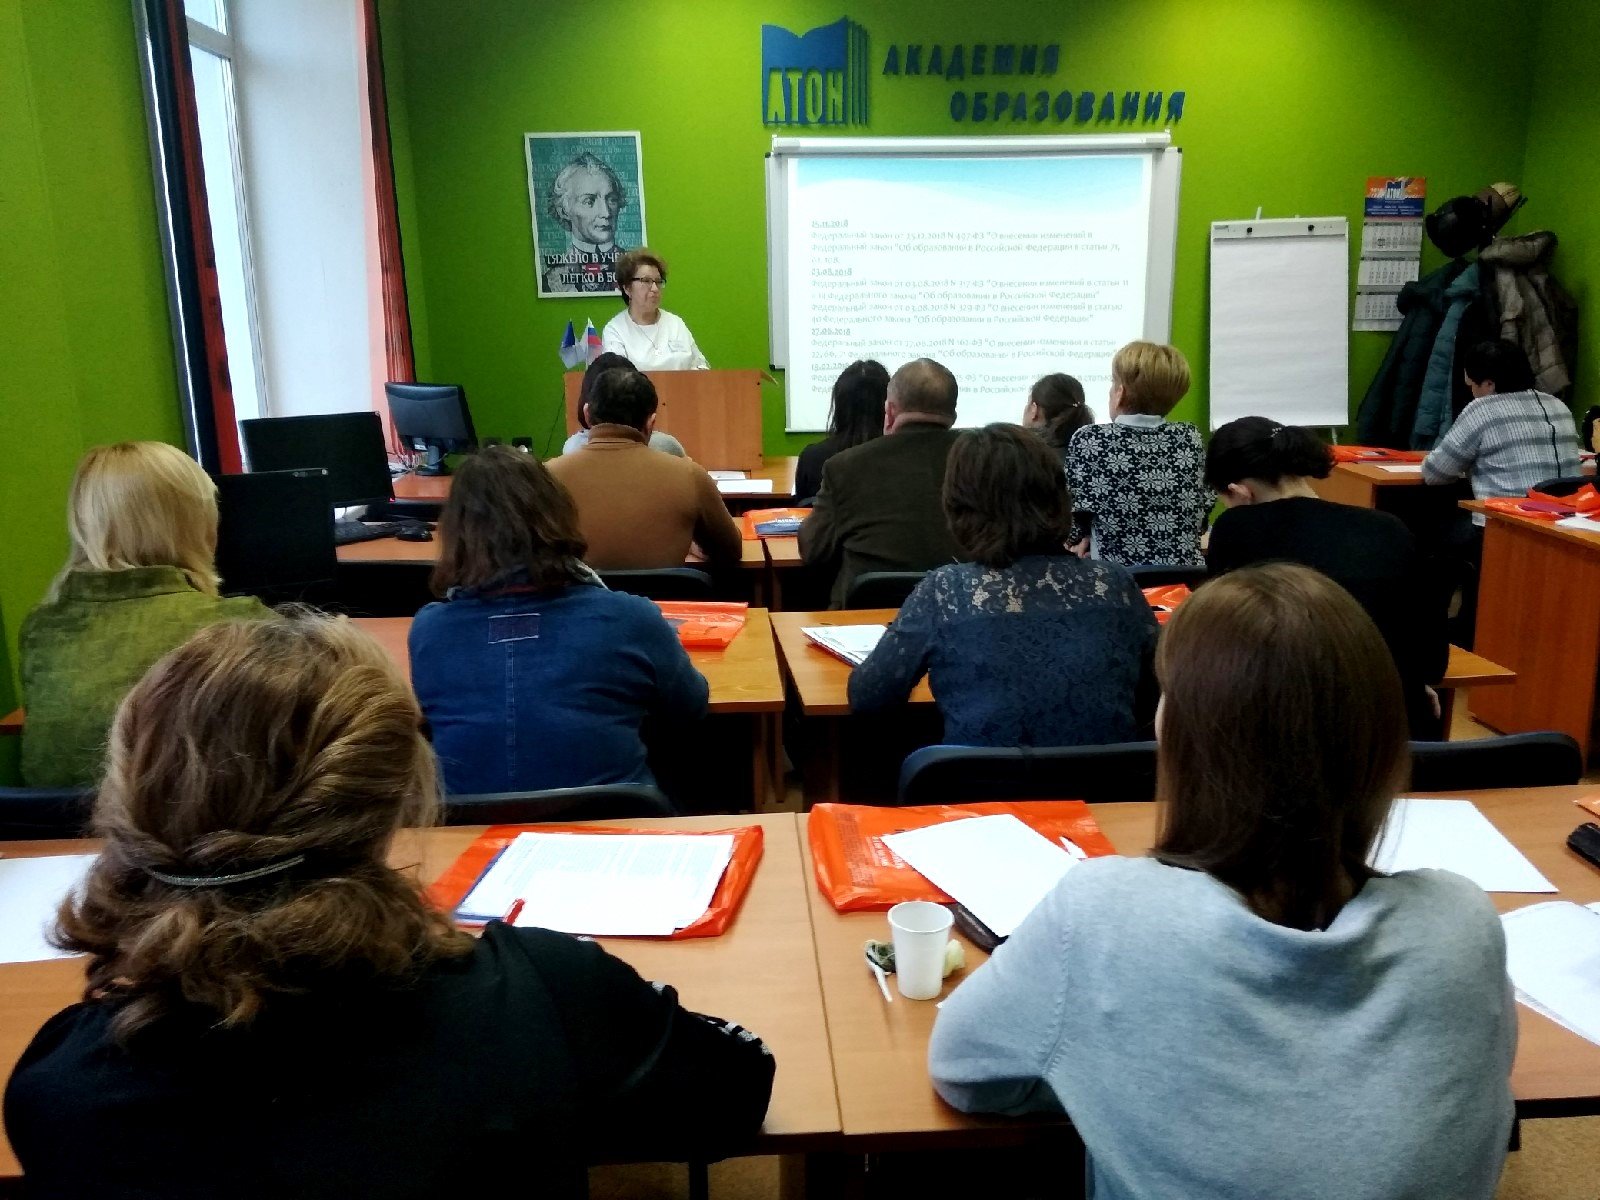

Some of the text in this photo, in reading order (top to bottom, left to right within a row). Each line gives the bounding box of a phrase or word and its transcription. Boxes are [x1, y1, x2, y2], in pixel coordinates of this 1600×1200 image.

[882, 44, 1061, 80] АКАДЕМИЯ
[767, 67, 844, 124] АТОН
[949, 90, 1186, 125] ОБРАЗОВАНИЯ
[547, 252, 589, 265] ТЯЖЕЛО
[592, 251, 599, 264] В
[562, 272, 595, 284] ЛЕГКО
[598, 272, 605, 283] В
